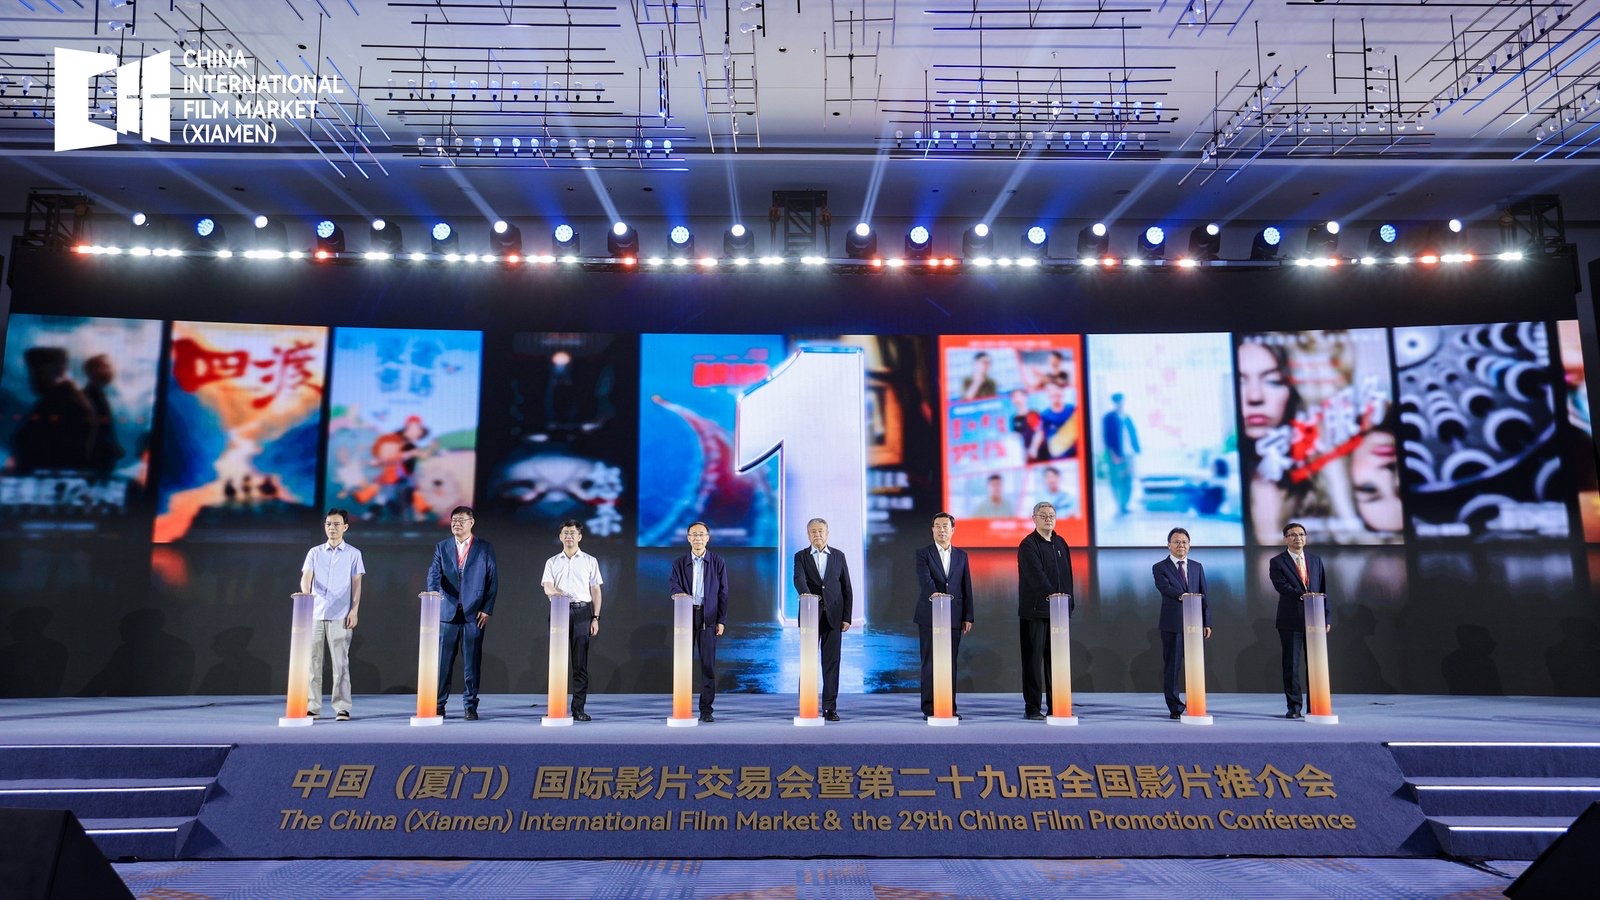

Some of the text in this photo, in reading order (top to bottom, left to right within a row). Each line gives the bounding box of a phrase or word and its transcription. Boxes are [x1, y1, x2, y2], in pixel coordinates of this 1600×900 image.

[735, 345, 866, 627] 1
[279, 810, 324, 830] The
[330, 810, 397, 830] China
[404, 810, 513, 833] (Xiamen)
[519, 811, 673, 831] International
[679, 811, 728, 831] Film
[852, 811, 891, 831] the
[898, 811, 953, 831] 29th
[959, 810, 1028, 831] China
[1033, 810, 1087, 831] Film
[1092, 810, 1214, 831] Promotion
[1218, 810, 1355, 831] Conference
